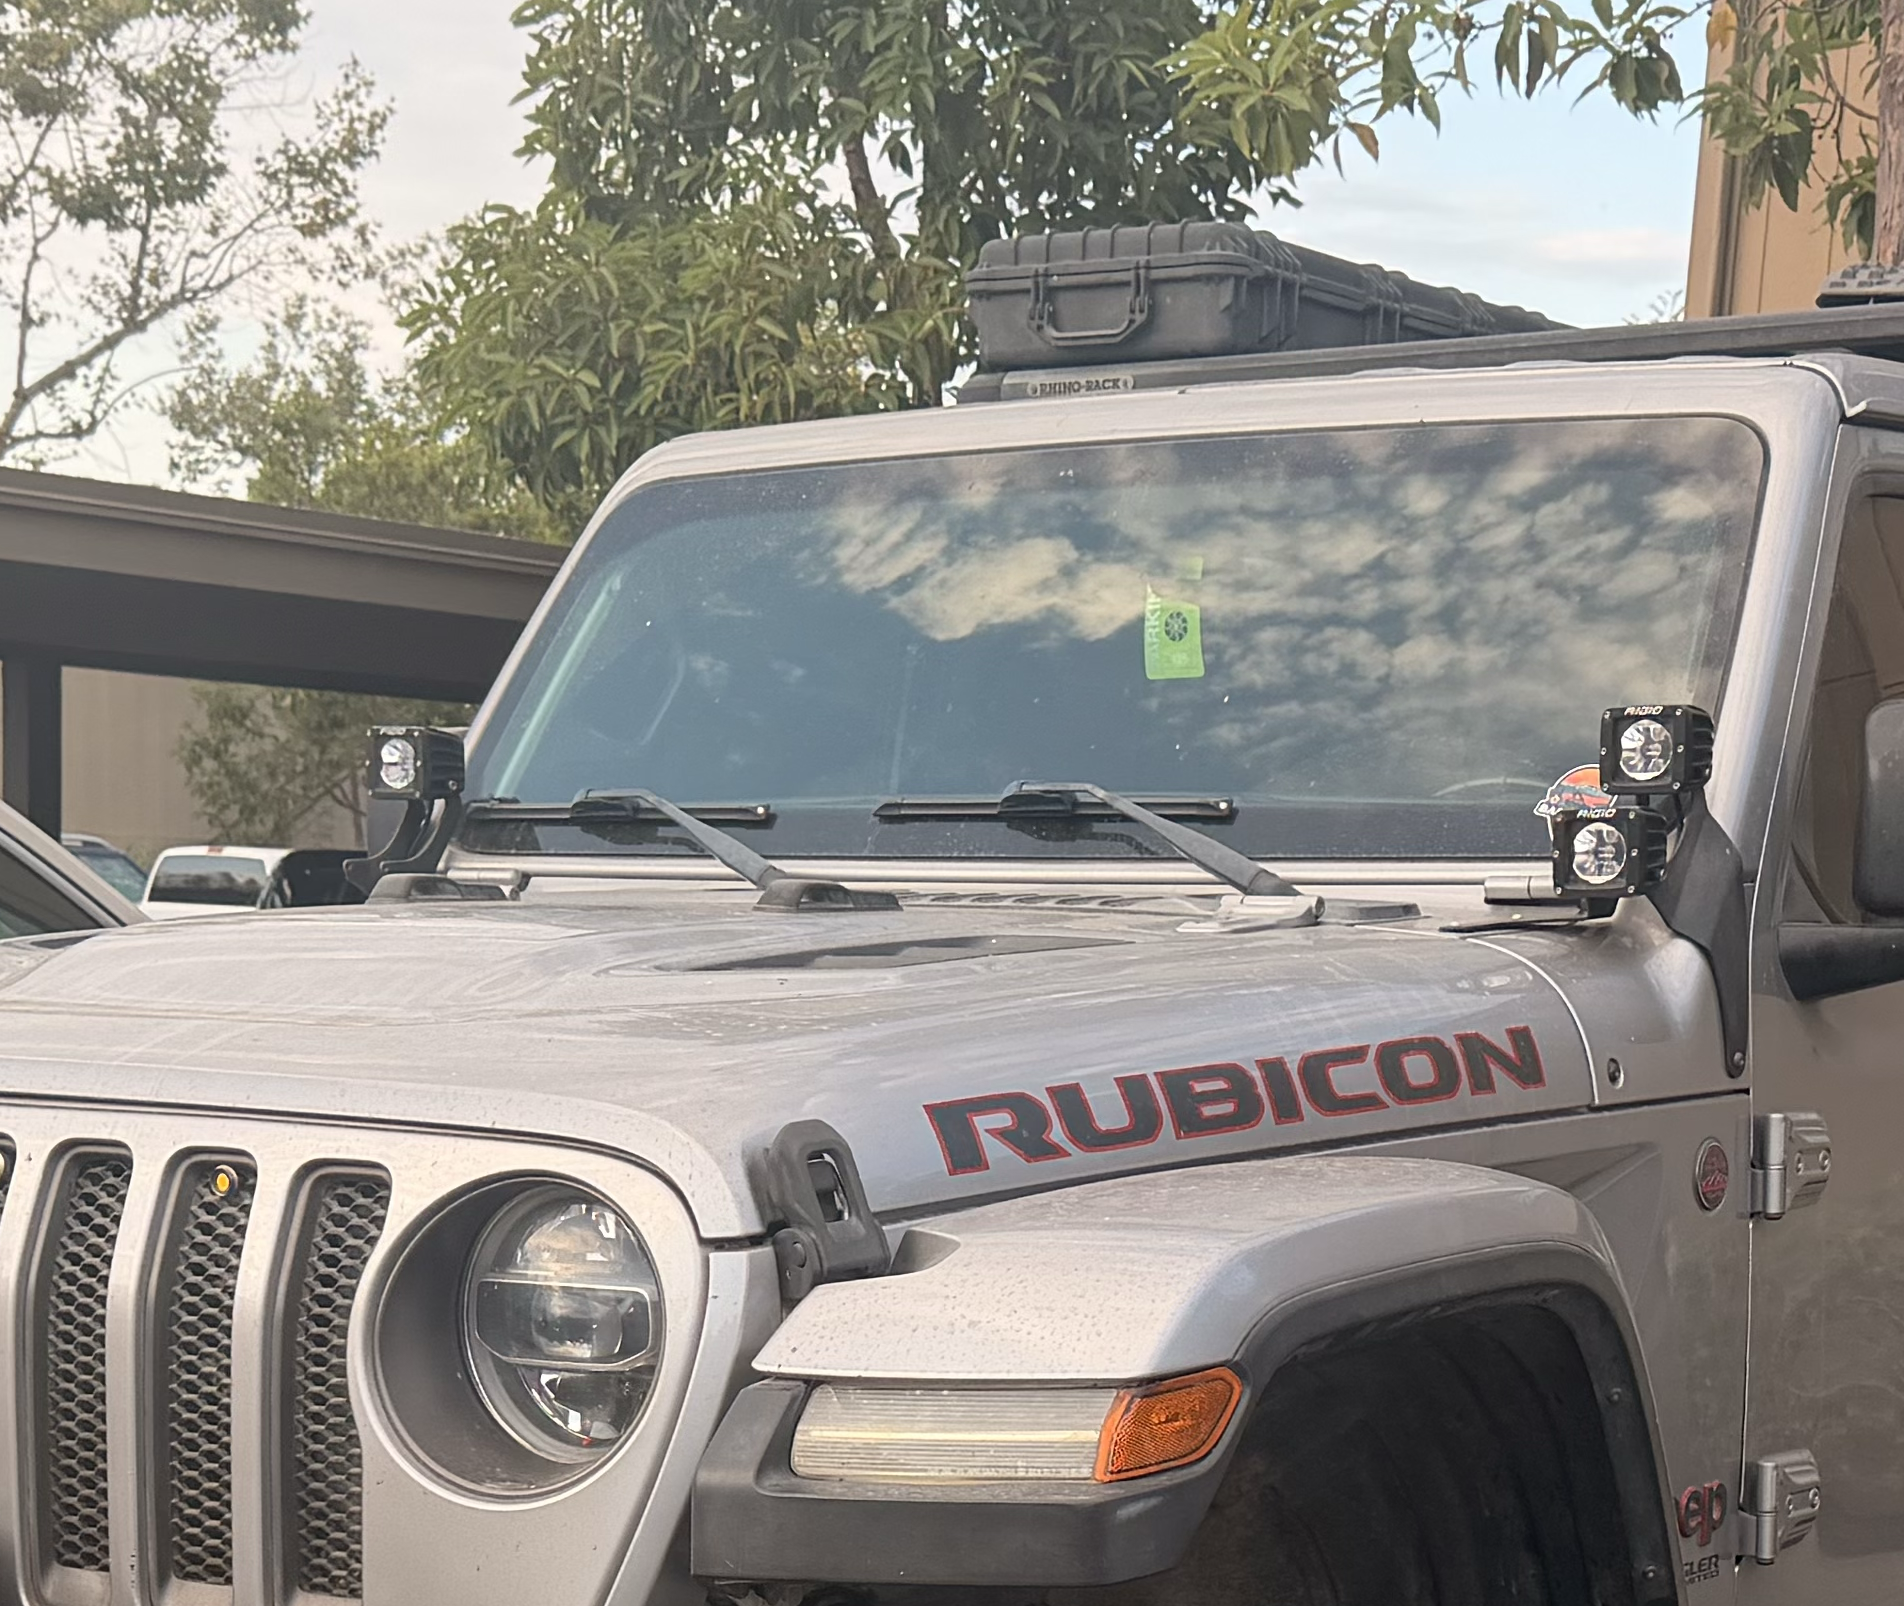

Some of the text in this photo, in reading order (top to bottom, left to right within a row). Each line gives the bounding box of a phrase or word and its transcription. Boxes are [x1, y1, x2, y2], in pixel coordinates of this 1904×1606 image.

[1039, 378, 1121, 396] RHINO-RACK
[922, 1024, 1546, 1177] RUBICON
[1678, 1480, 1728, 1547] ep
